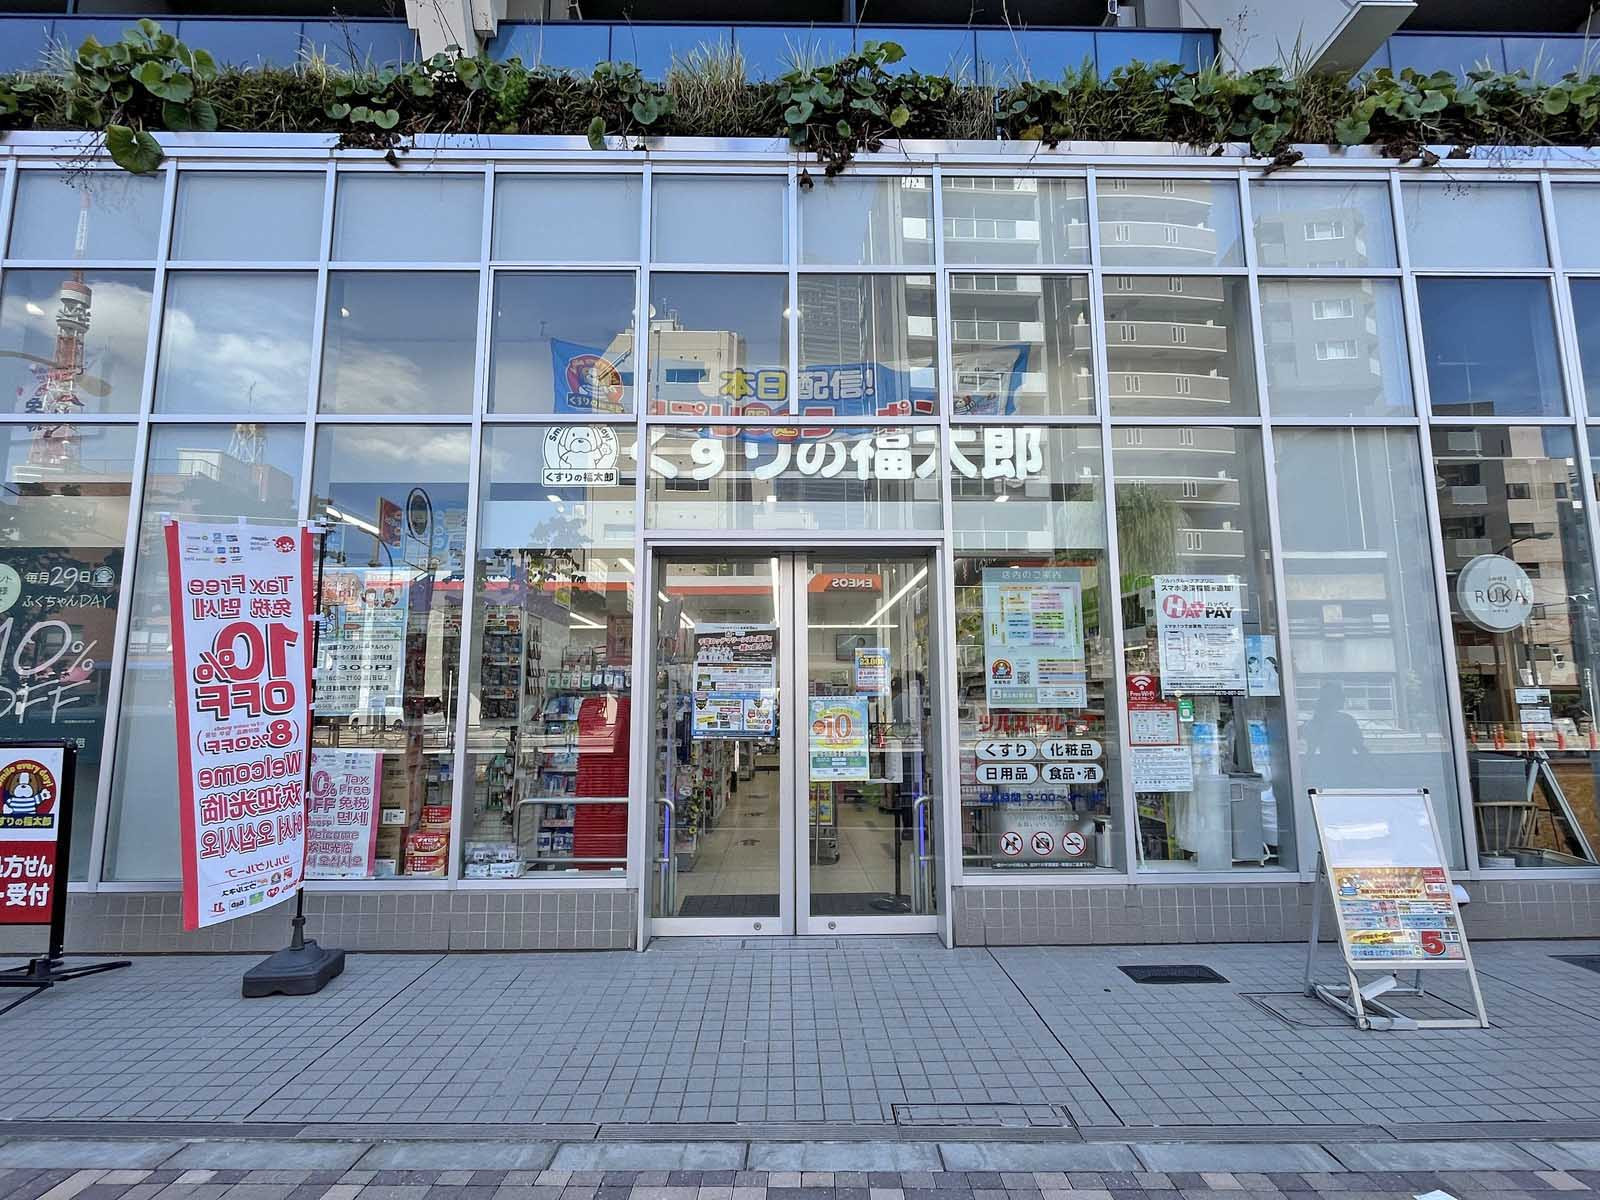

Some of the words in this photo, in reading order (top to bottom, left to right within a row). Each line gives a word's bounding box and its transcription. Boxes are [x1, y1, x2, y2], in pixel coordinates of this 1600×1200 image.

[631, 427, 1042, 481] くすりの福太郎
[545, 471, 614, 483] くすりの福太郎
[1474, 589, 1527, 604] RUKA
[1205, 607, 1235, 619] PAY
[985, 743, 1027, 757] くすり
[1050, 743, 1093, 757] 化粧品
[343, 773, 370, 785] Tax
[986, 767, 1028, 781] 日用品
[1049, 766, 1097, 781] 食品・酒
[312, 770, 337, 798] 0%
[339, 785, 371, 796] Free
[308, 798, 337, 814] FF
[339, 796, 370, 811] 免税
[0, 815, 53, 828] すりの福太郎
[336, 811, 369, 827] 면세
[0, 882, 50, 908] 受付
[1421, 930, 1446, 956] 5
